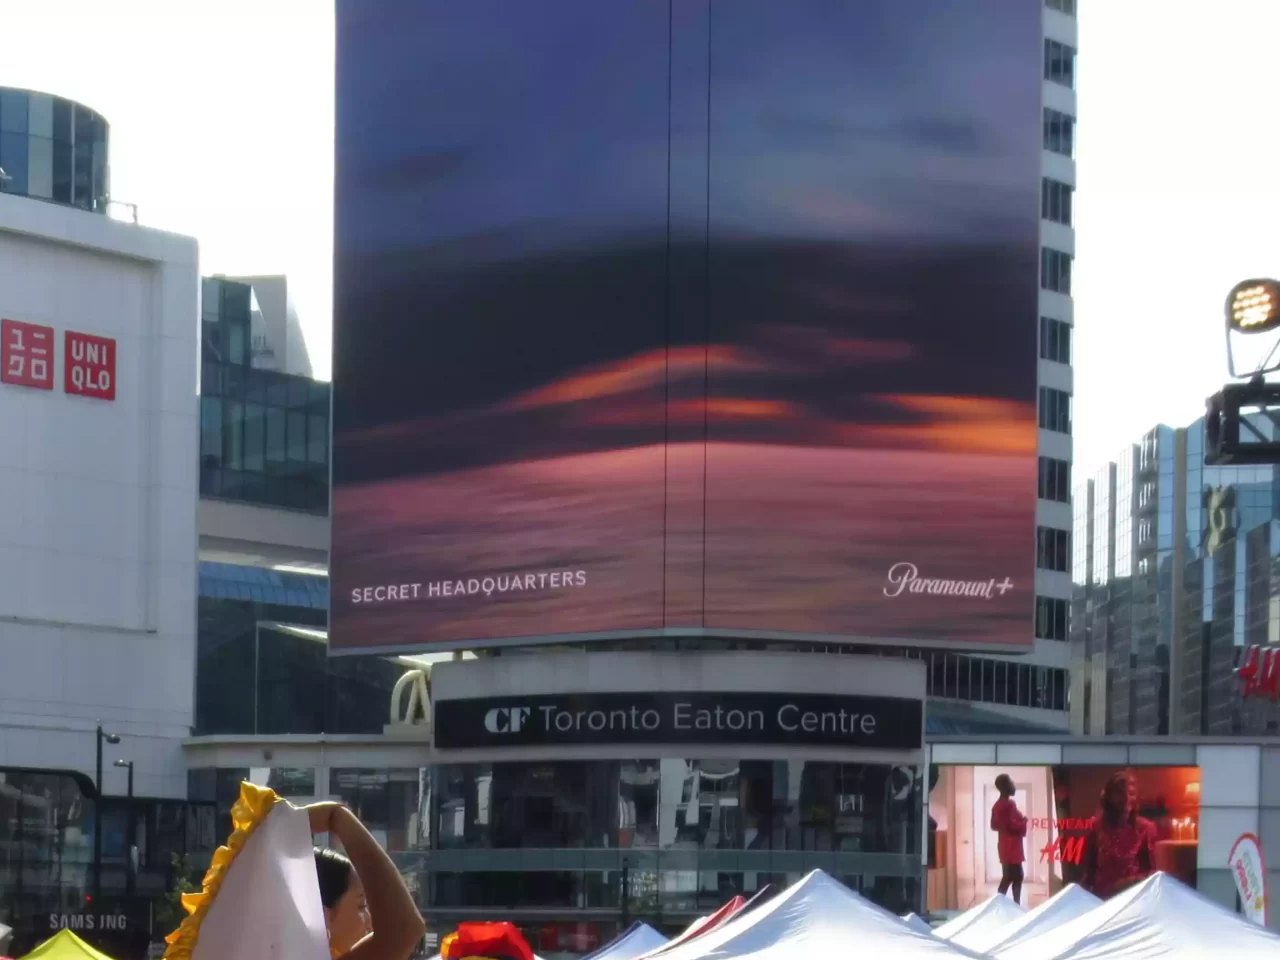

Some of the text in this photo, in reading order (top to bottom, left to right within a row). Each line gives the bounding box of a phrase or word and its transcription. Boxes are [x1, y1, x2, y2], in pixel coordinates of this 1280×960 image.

[71, 339, 107, 366] UNI
[71, 365, 111, 391] QLO
[351, 570, 587, 604] SECRET HEADQUARTERS
[882, 561, 1014, 600] Paramount+
[483, 703, 877, 735] CF Toronto Eaton Centre
[1039, 836, 1087, 866] H&M
